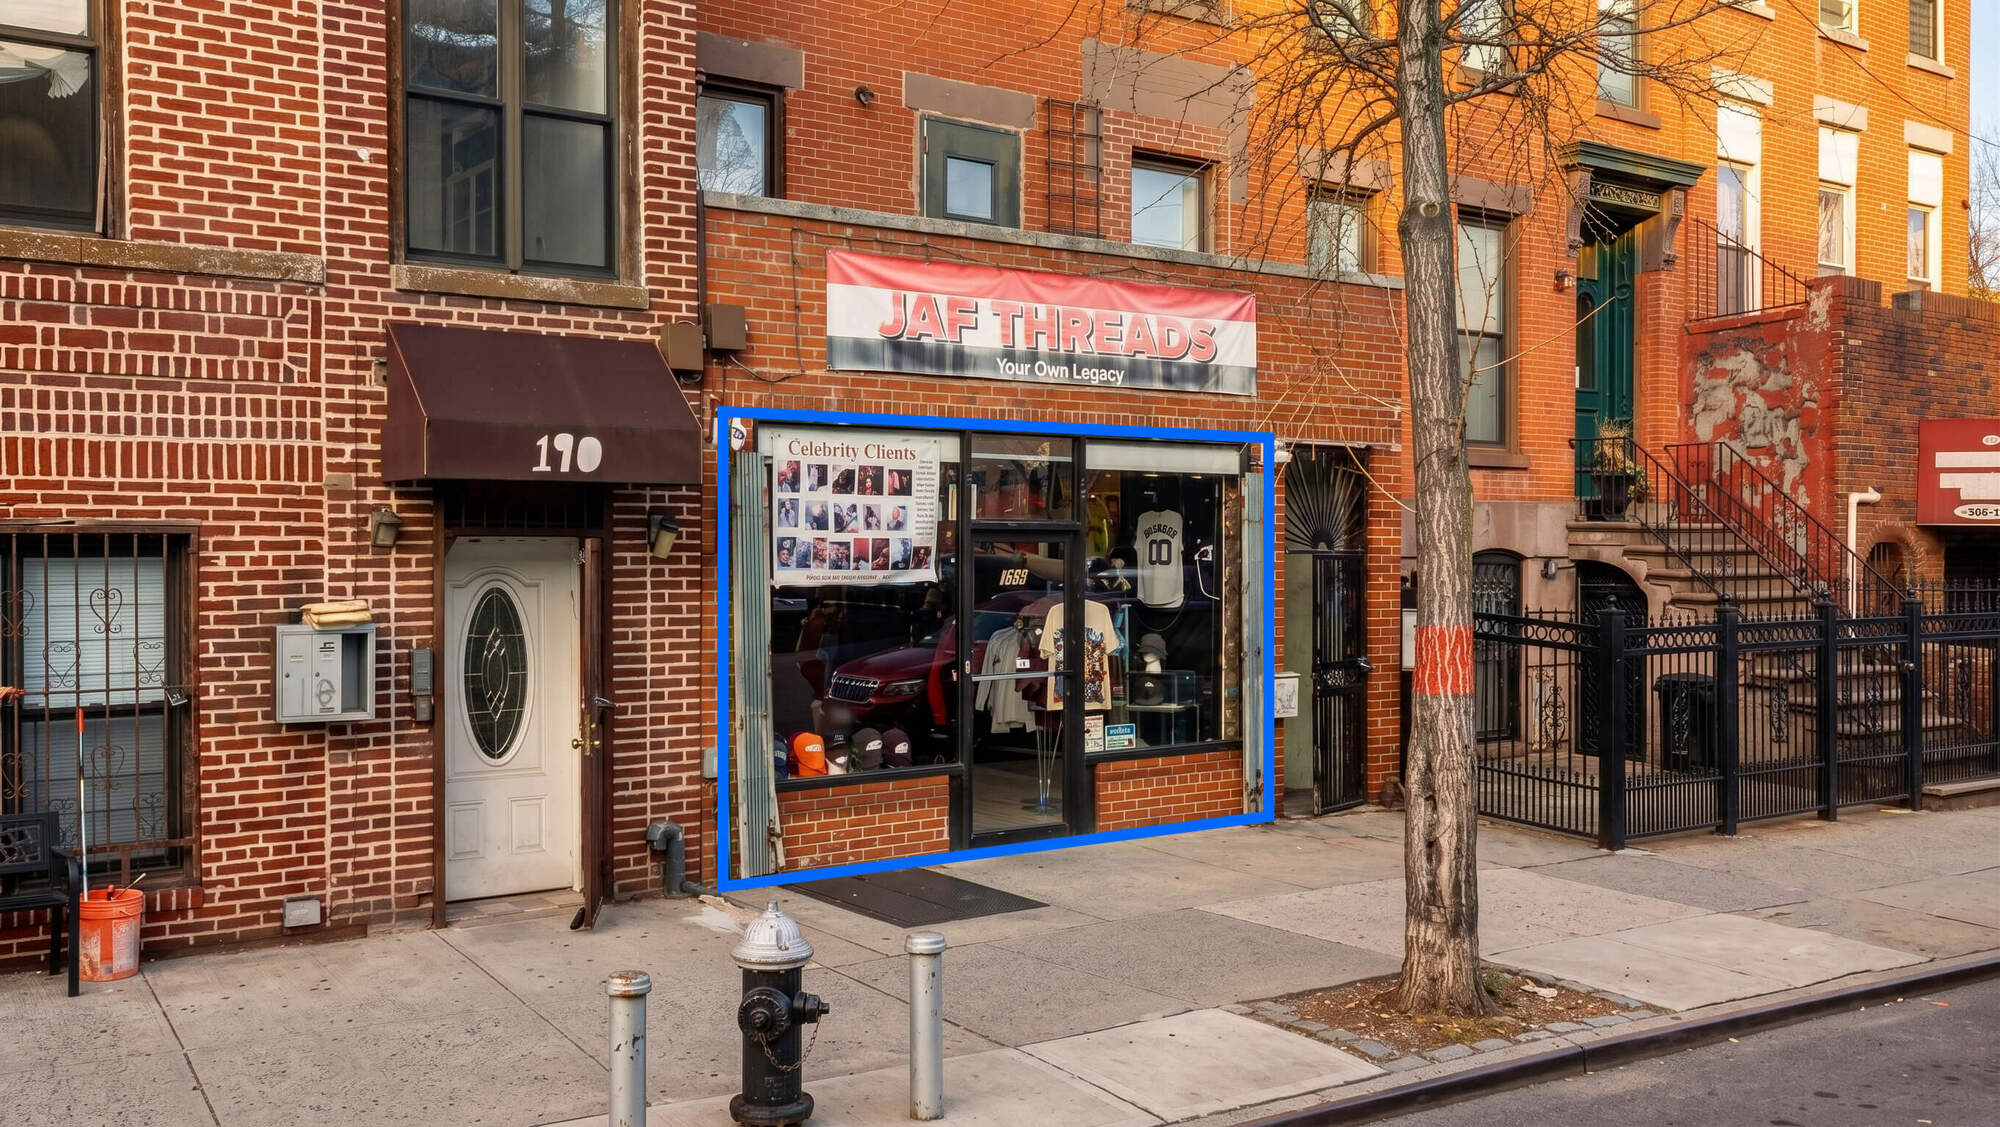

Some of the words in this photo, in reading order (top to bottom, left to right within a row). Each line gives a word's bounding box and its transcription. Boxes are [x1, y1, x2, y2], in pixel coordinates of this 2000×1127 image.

[878, 290, 979, 344] JAF
[991, 300, 1218, 363] THREADS
[996, 357, 1031, 378] Your
[1034, 361, 1069, 379] Own
[1073, 363, 1125, 385] Legacy
[532, 433, 602, 472] 190
[788, 440, 859, 462] Celebrity
[864, 443, 916, 461] Clients
